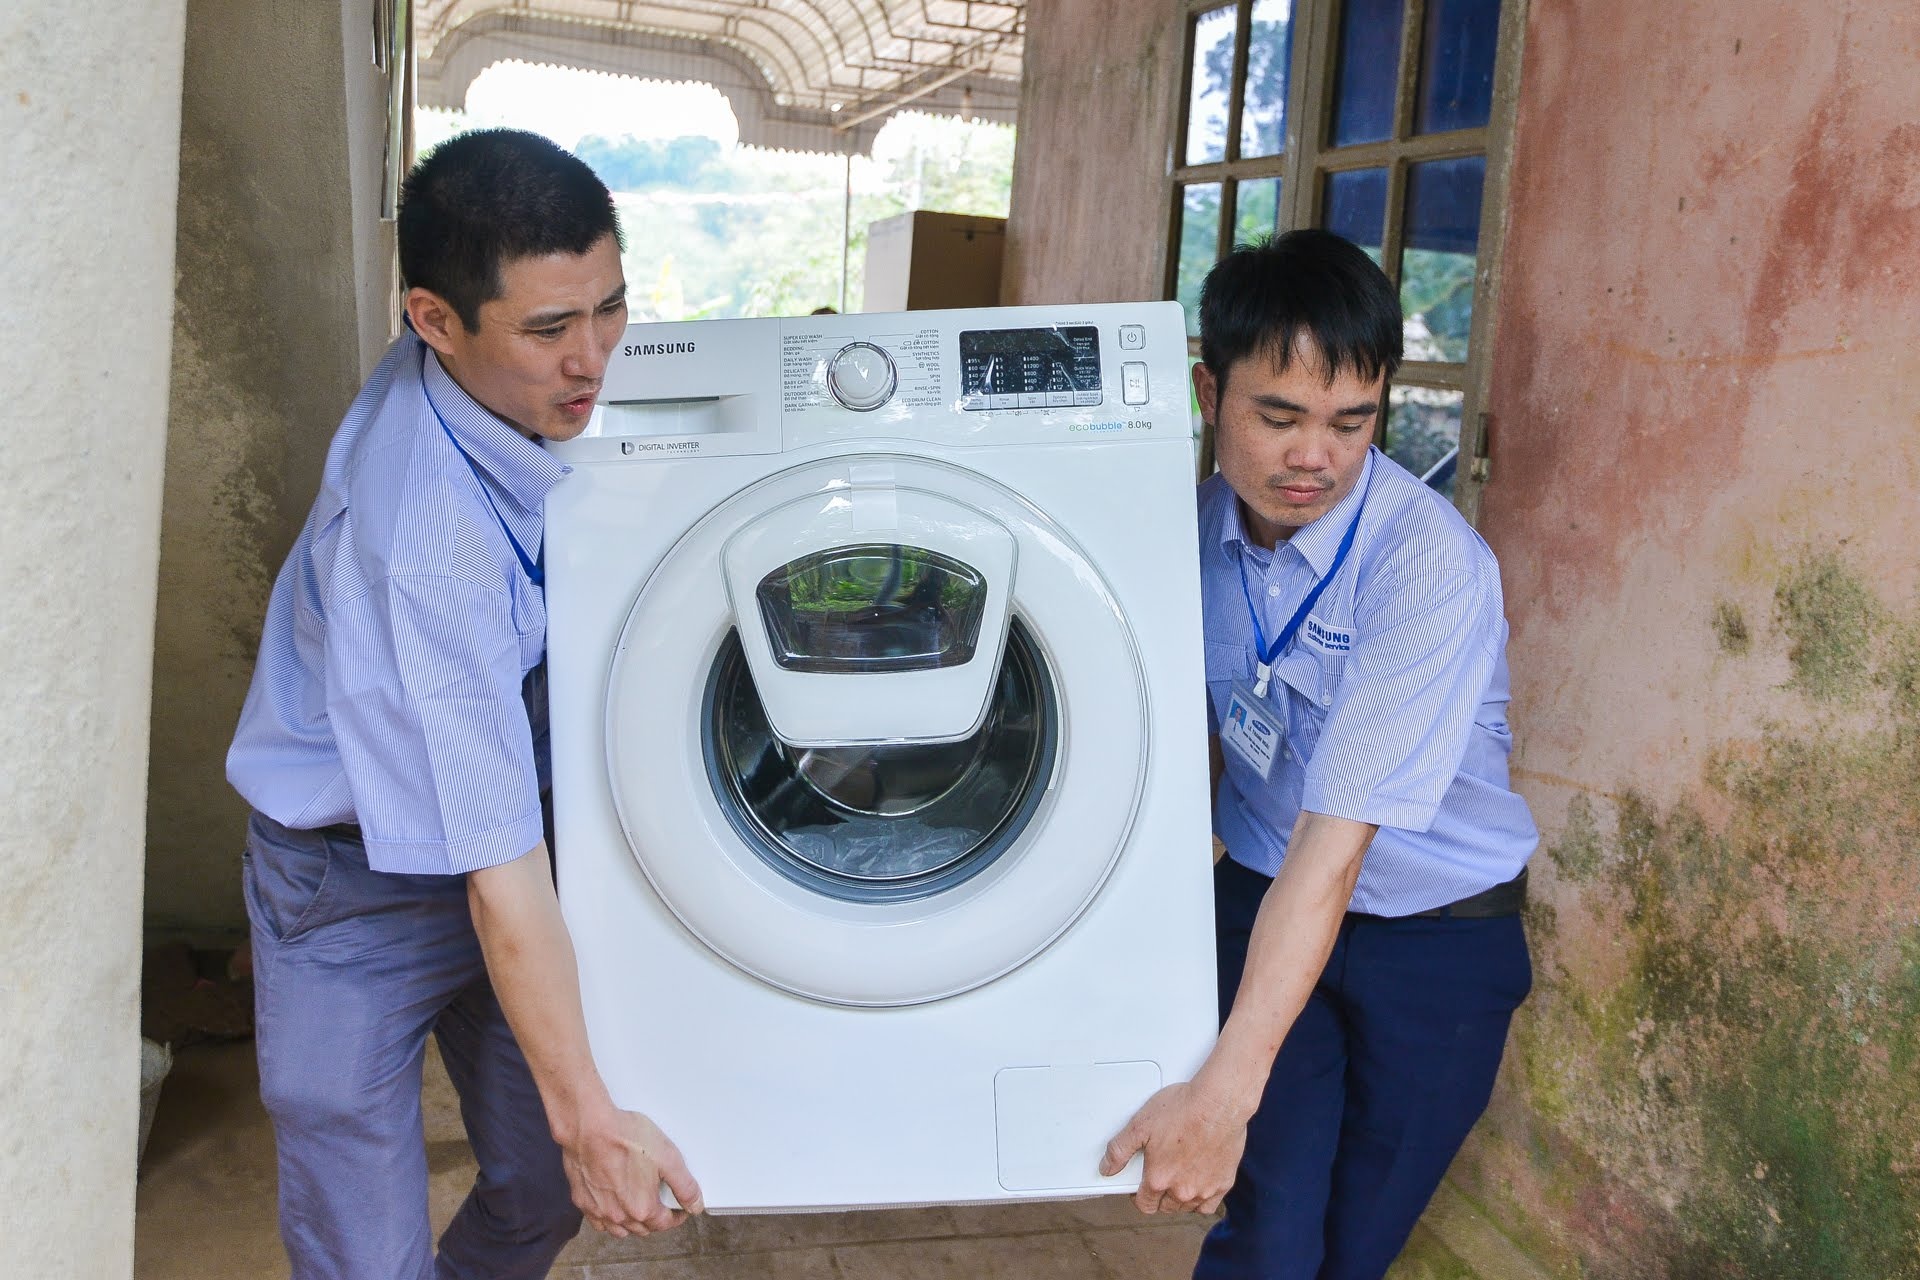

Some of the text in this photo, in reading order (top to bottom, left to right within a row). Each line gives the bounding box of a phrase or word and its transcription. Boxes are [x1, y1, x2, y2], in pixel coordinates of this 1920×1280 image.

[624, 342, 695, 357] SAMSUNG
[1069, 420, 1152, 431] ecobubble 8.0kg
[638, 441, 700, 451] DIGITAL INVERTER
